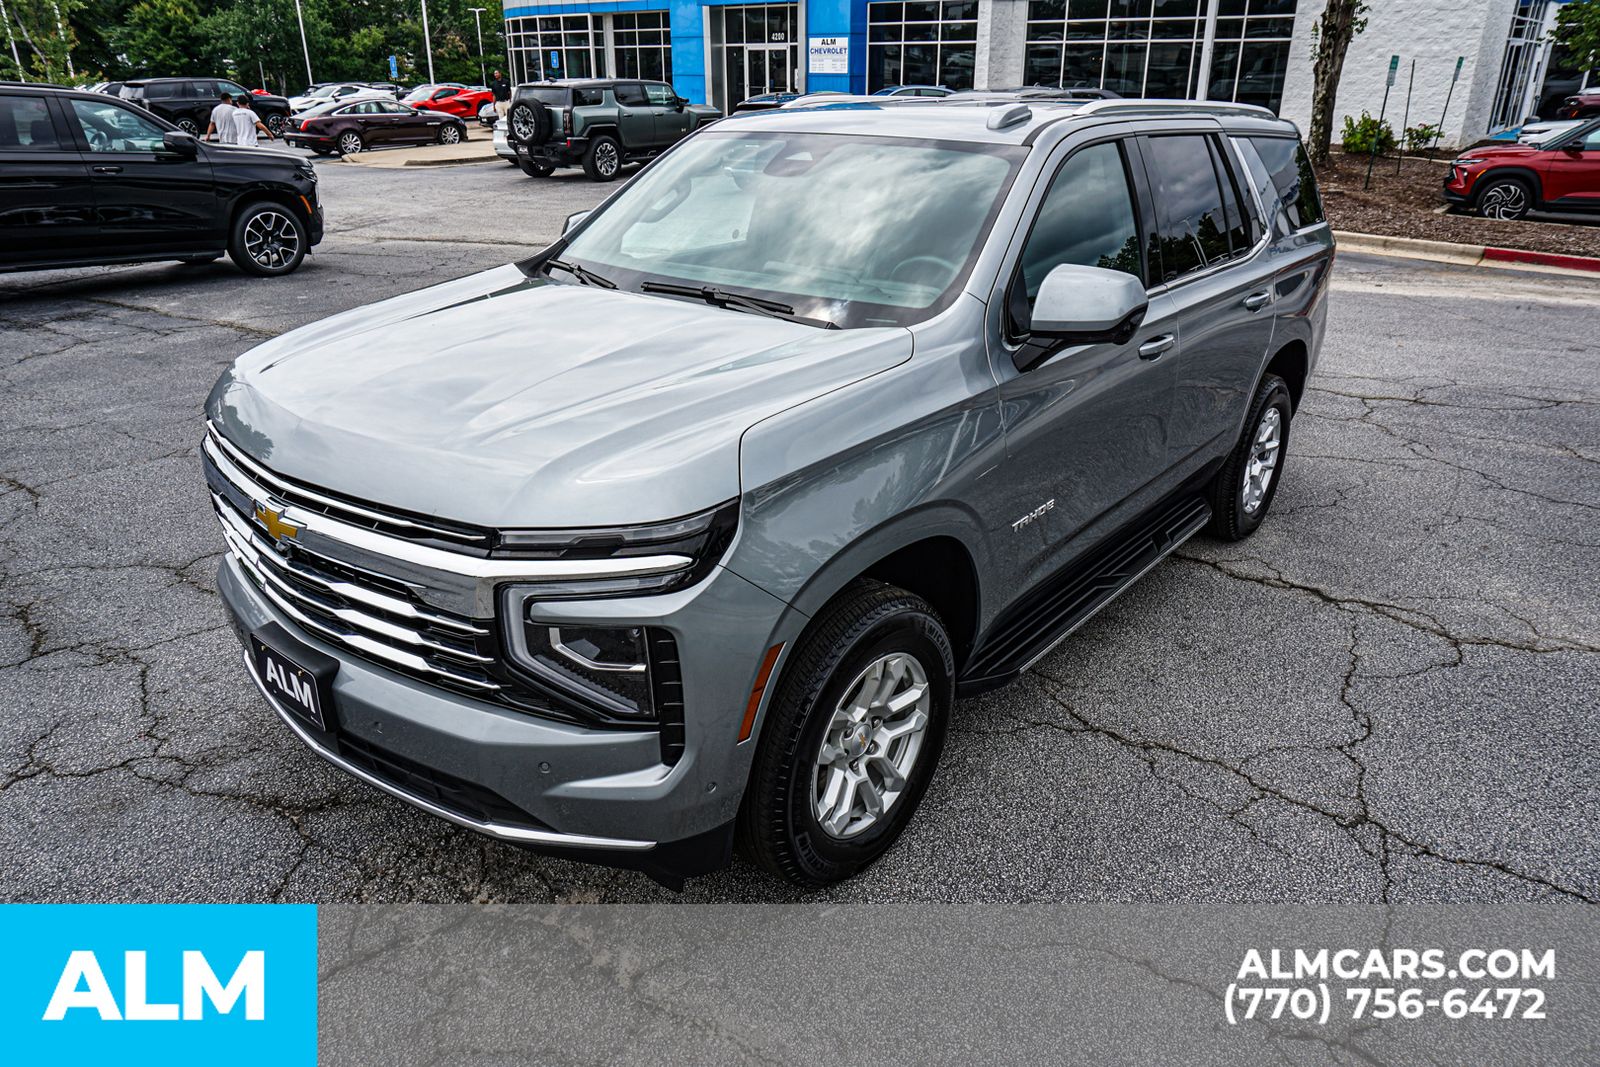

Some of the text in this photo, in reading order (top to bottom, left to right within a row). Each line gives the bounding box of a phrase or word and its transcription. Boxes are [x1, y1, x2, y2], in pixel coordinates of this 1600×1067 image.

[771, 32, 785, 40] 4200
[1011, 498, 1055, 533] TAHOE
[926, 620, 954, 675] MICHELIN
[266, 656, 316, 714] ALM
